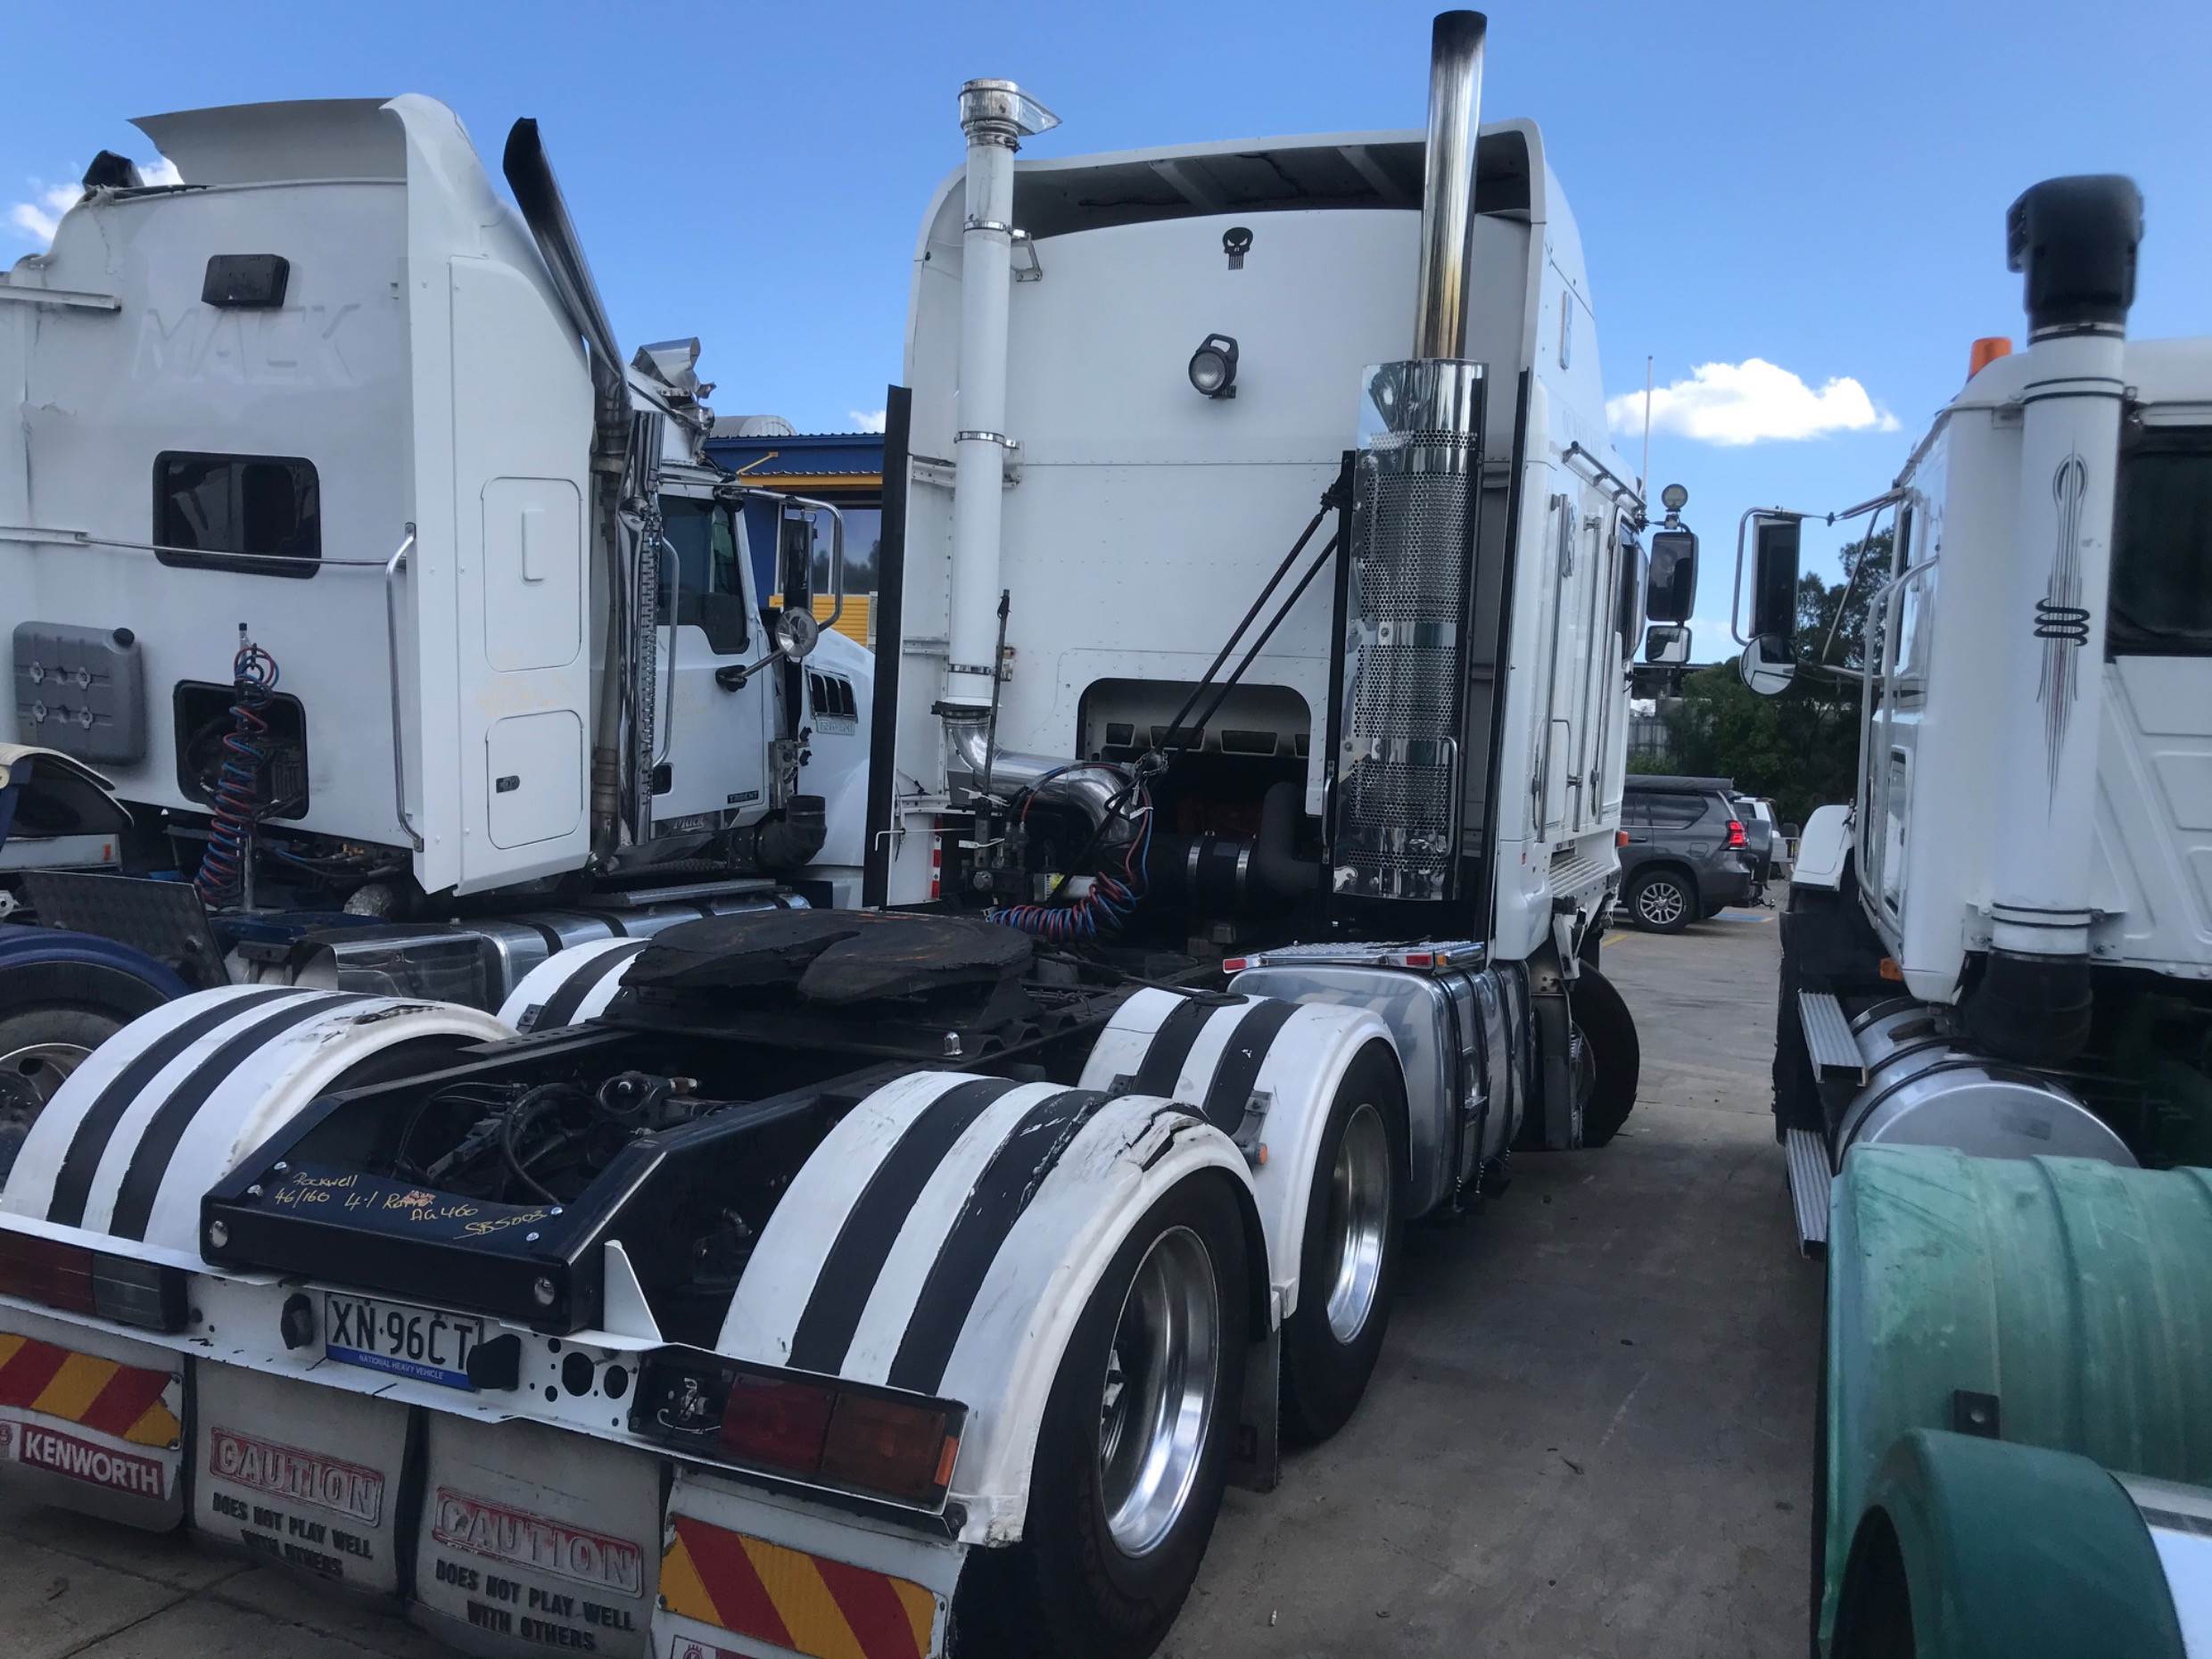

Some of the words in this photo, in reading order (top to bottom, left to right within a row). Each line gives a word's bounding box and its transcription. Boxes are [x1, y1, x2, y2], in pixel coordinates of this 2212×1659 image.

[729, 791, 758, 804] TRIDENT
[275, 1187, 330, 1209] 46/160
[359, 1354, 392, 1368] NATIONAL
[392, 1360, 417, 1373] HEAVY
[416, 1366, 444, 1380] VEHICLE
[25, 1431, 159, 1495] KENWORTH
[218, 1437, 378, 1520] CAUTION
[212, 1491, 248, 1520] DOES
[253, 1506, 284, 1531] NOT
[288, 1516, 326, 1544] PLAY
[331, 1529, 374, 1560] WELL
[442, 1499, 636, 1589] CAUTION
[435, 1559, 480, 1591] DOES
[486, 1574, 522, 1604] NOT
[529, 1588, 574, 1618] PLAY
[582, 1601, 636, 1632] WELL
[467, 1599, 512, 1632] WITH
[521, 1616, 597, 1650] OTHERS
